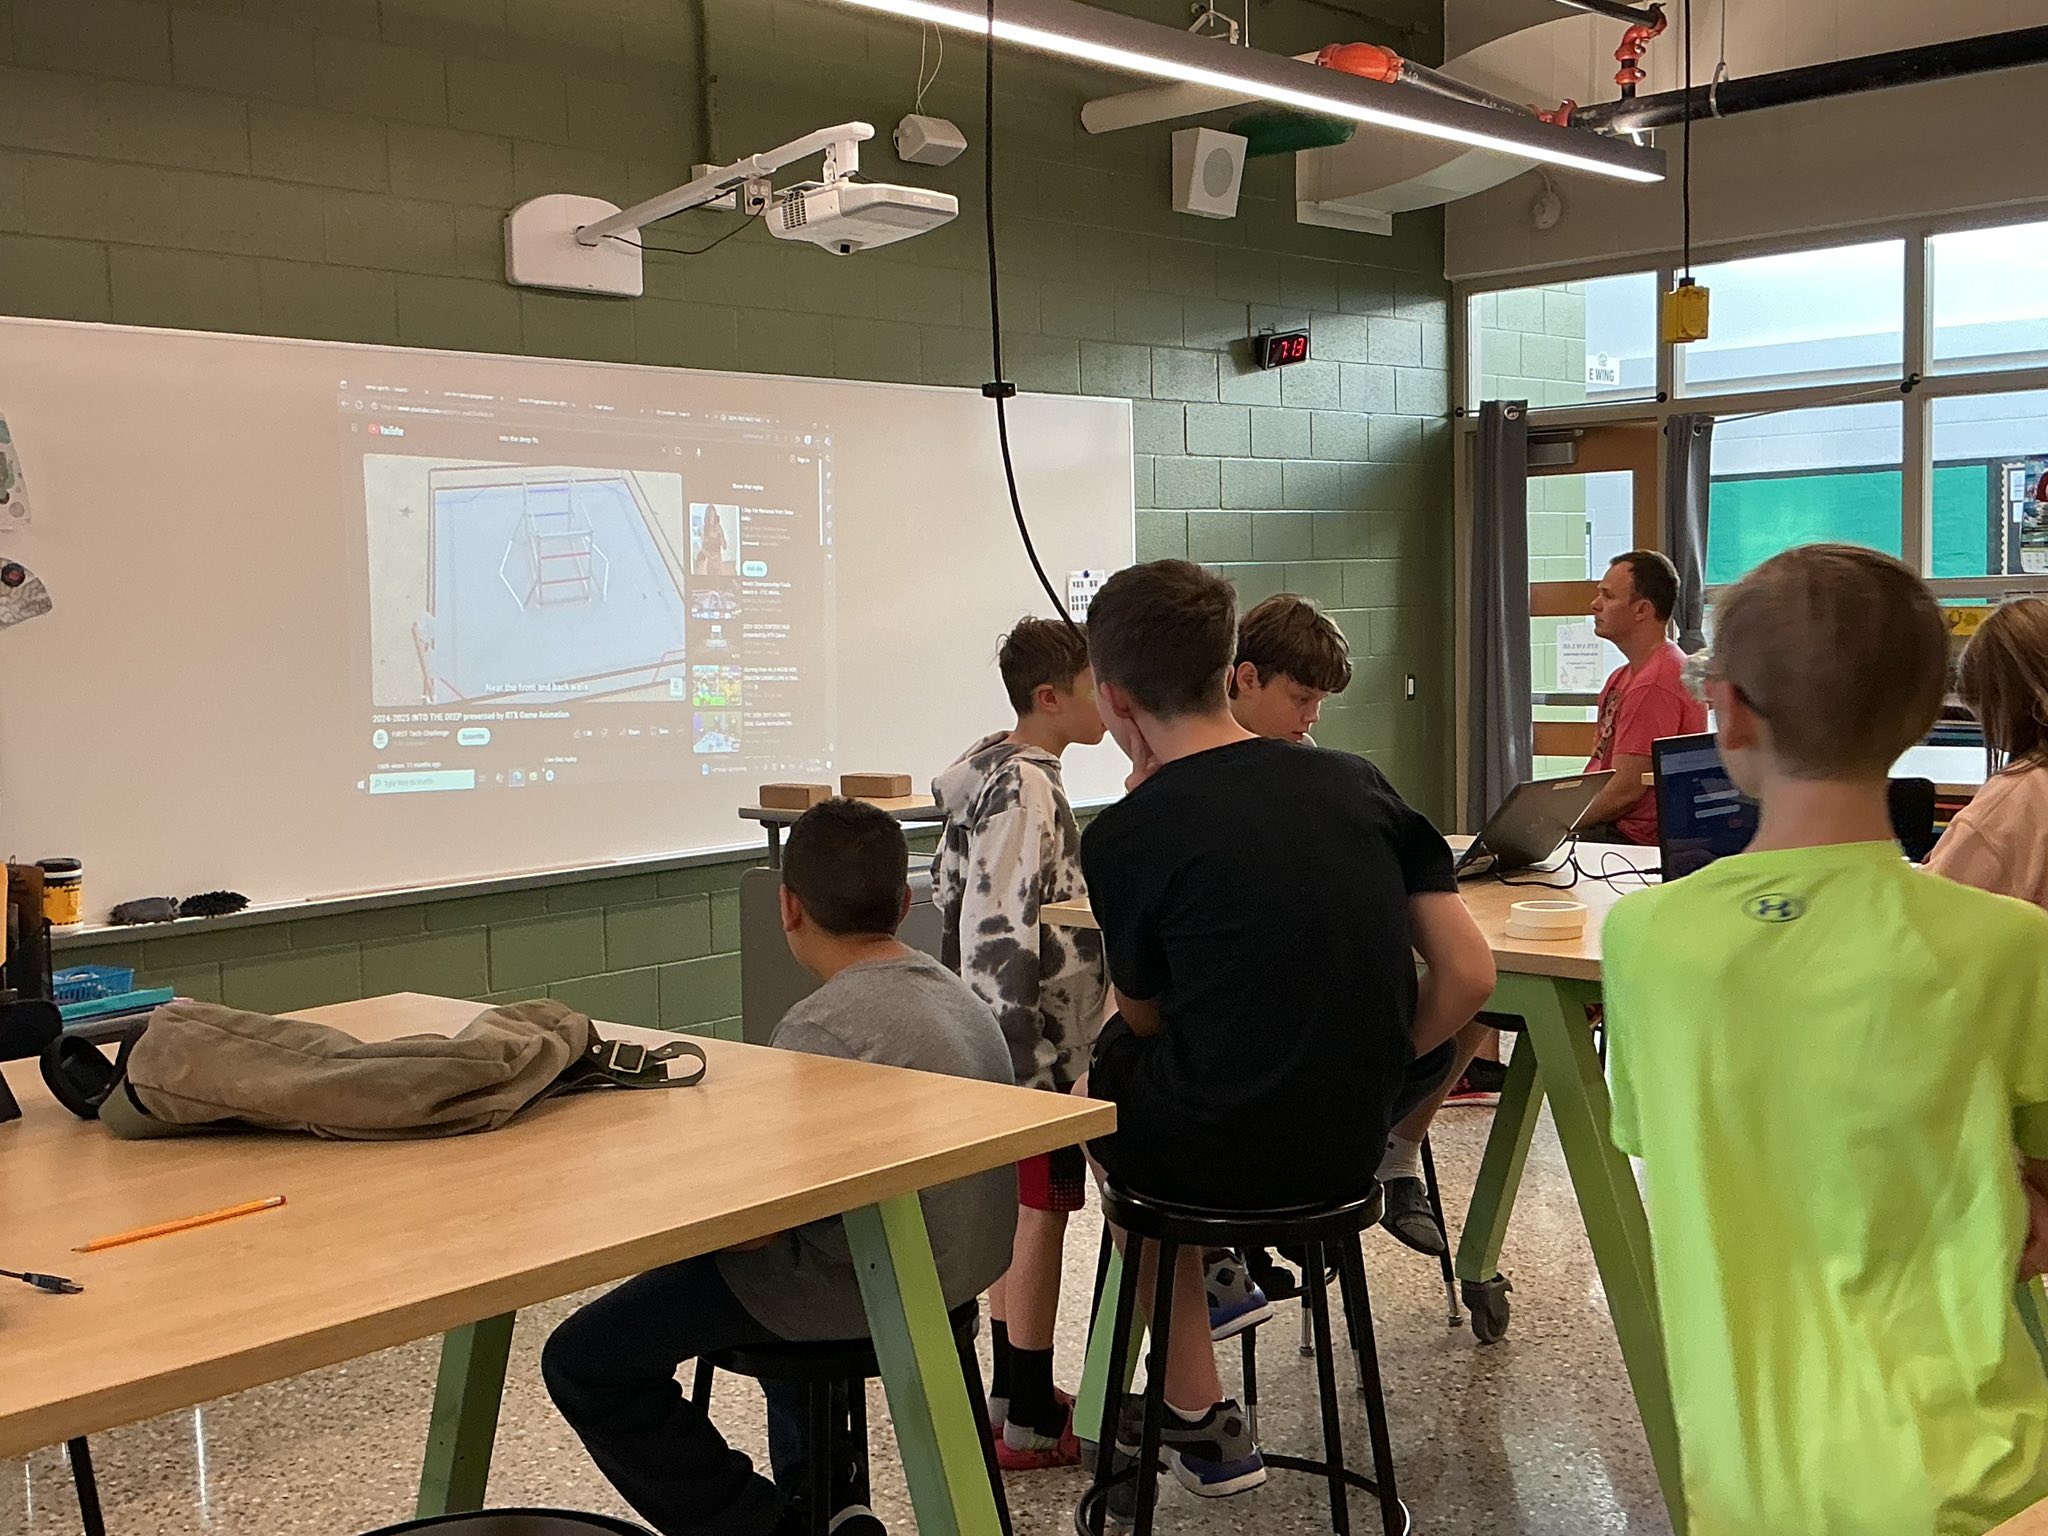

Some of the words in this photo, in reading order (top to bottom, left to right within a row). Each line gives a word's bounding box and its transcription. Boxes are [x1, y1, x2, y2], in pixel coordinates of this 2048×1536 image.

[1281, 337, 1305, 359] 7:13
[1589, 368, 1594, 380] E
[1595, 369, 1615, 382] WING
[485, 682, 503, 692] Near
[504, 682, 517, 692] the
[518, 682, 537, 692] front
[538, 682, 551, 692] and
[551, 681, 569, 692] back
[570, 681, 589, 692] walls
[372, 712, 410, 723] 2024-2025
[411, 712, 428, 722] INTO
[429, 712, 444, 722] THE
[445, 711, 462, 722] DEEP
[463, 711, 495, 722] presented
[496, 711, 504, 721] by
[519, 711, 538, 720] Game
[538, 709, 570, 720] Animation
